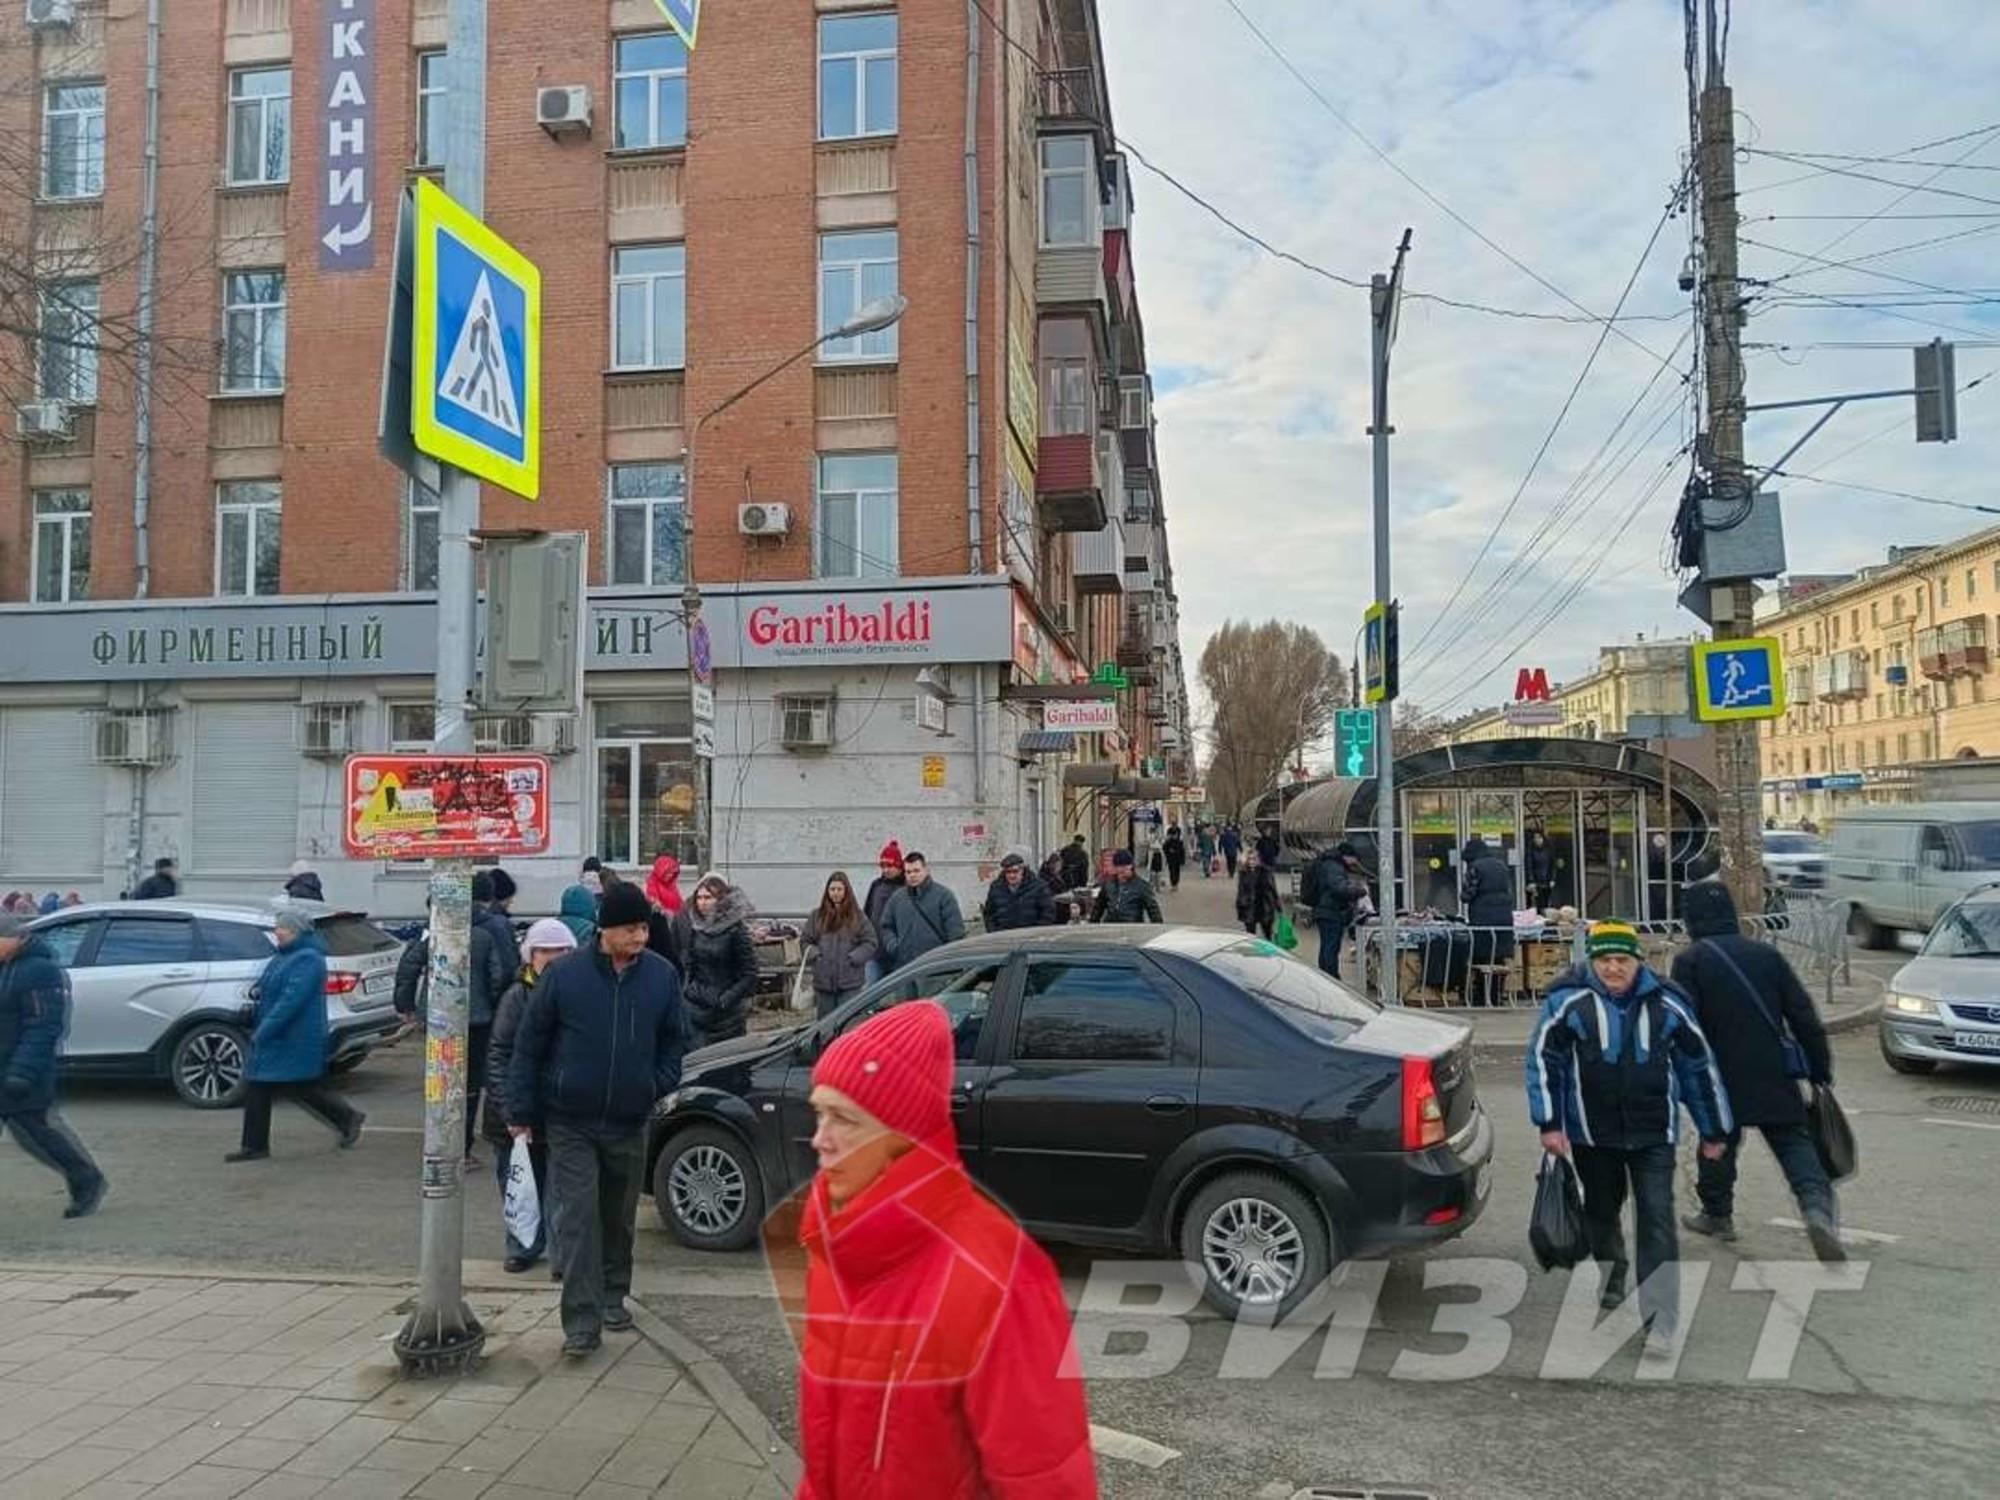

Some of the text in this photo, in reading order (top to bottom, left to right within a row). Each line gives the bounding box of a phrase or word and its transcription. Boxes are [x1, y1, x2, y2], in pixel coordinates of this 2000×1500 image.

[328, 0, 366, 206] КАНИ
[92, 615, 383, 665] ФИРМЕННЫЙ
[749, 600, 931, 645] Garibaldi
[1047, 708, 1112, 724] Garibaldi
[1341, 711, 1371, 743] 59
